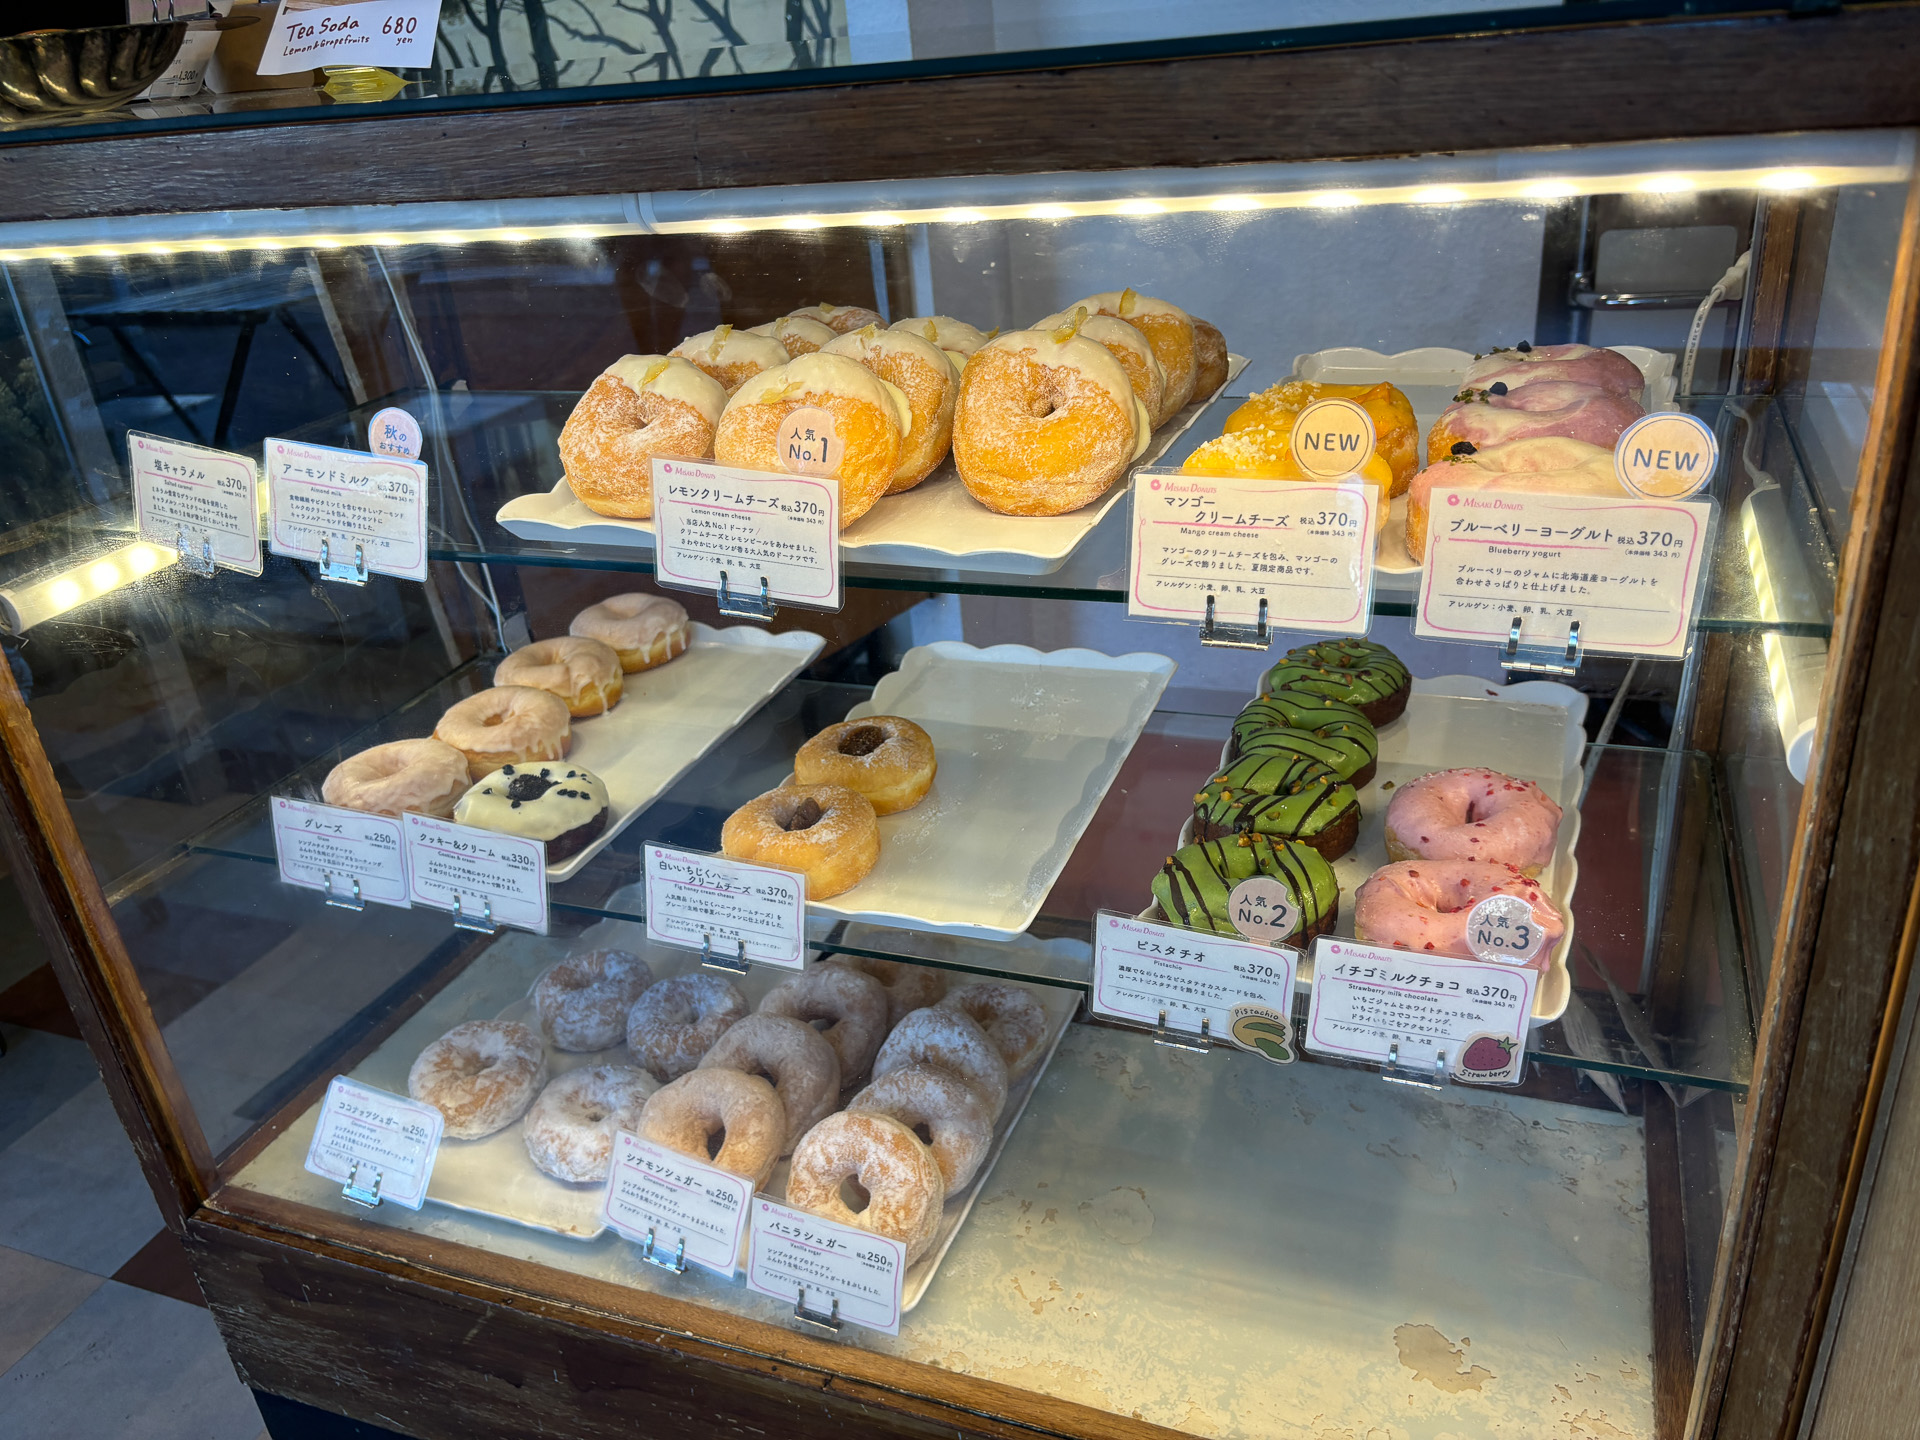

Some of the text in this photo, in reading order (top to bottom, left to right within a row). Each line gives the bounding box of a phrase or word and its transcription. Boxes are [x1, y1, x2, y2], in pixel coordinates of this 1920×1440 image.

[287, 16, 417, 42] Tea Soda 680
[396, 37, 412, 46] yen
[384, 425, 407, 441] 秋の
[790, 427, 816, 442] 人気
[1304, 432, 1360, 451] NEW
[379, 442, 410, 455] おすすめ
[789, 437, 828, 463] No.1
[1633, 448, 1700, 471] NEW
[153, 458, 206, 481] 塩キャラメル
[282, 462, 369, 488] アーモンドミルク
[310, 486, 329, 494] Almond
[668, 483, 779, 510] レモンクリームチーズ
[1164, 495, 1216, 507] マンゴー
[690, 507, 710, 516] Lemon
[731, 513, 751, 521] cheese
[1195, 510, 1290, 527] クリームチーズ
[1181, 527, 1259, 539] Mango cream cheese
[1449, 519, 1613, 543] ブルーベリーヨーグルト
[1488, 545, 1561, 559] Blueberry yogurt
[1653, 550, 1669, 558] 343
[304, 817, 343, 834] グレーズ
[659, 859, 738, 884] 白いいちじくハニー
[683, 885, 699, 893] honey
[688, 874, 751, 895] クリームチーズ
[1239, 894, 1268, 908] 人気
[1238, 904, 1288, 928] No.2
[1479, 915, 1510, 929] 人気
[1477, 925, 1530, 950] No.3
[1136, 939, 1206, 963] ピスタチオ
[1153, 959, 1182, 970] Pistachio
[1333, 962, 1461, 992] イチゴミルクチョコ
[1347, 983, 1438, 1002] Strawberry milk chocolate
[337, 1100, 400, 1128] ココナッツシュガー
[625, 1152, 703, 1191] シナモンシュガー
[768, 1219, 847, 1253] バニラシュガー
